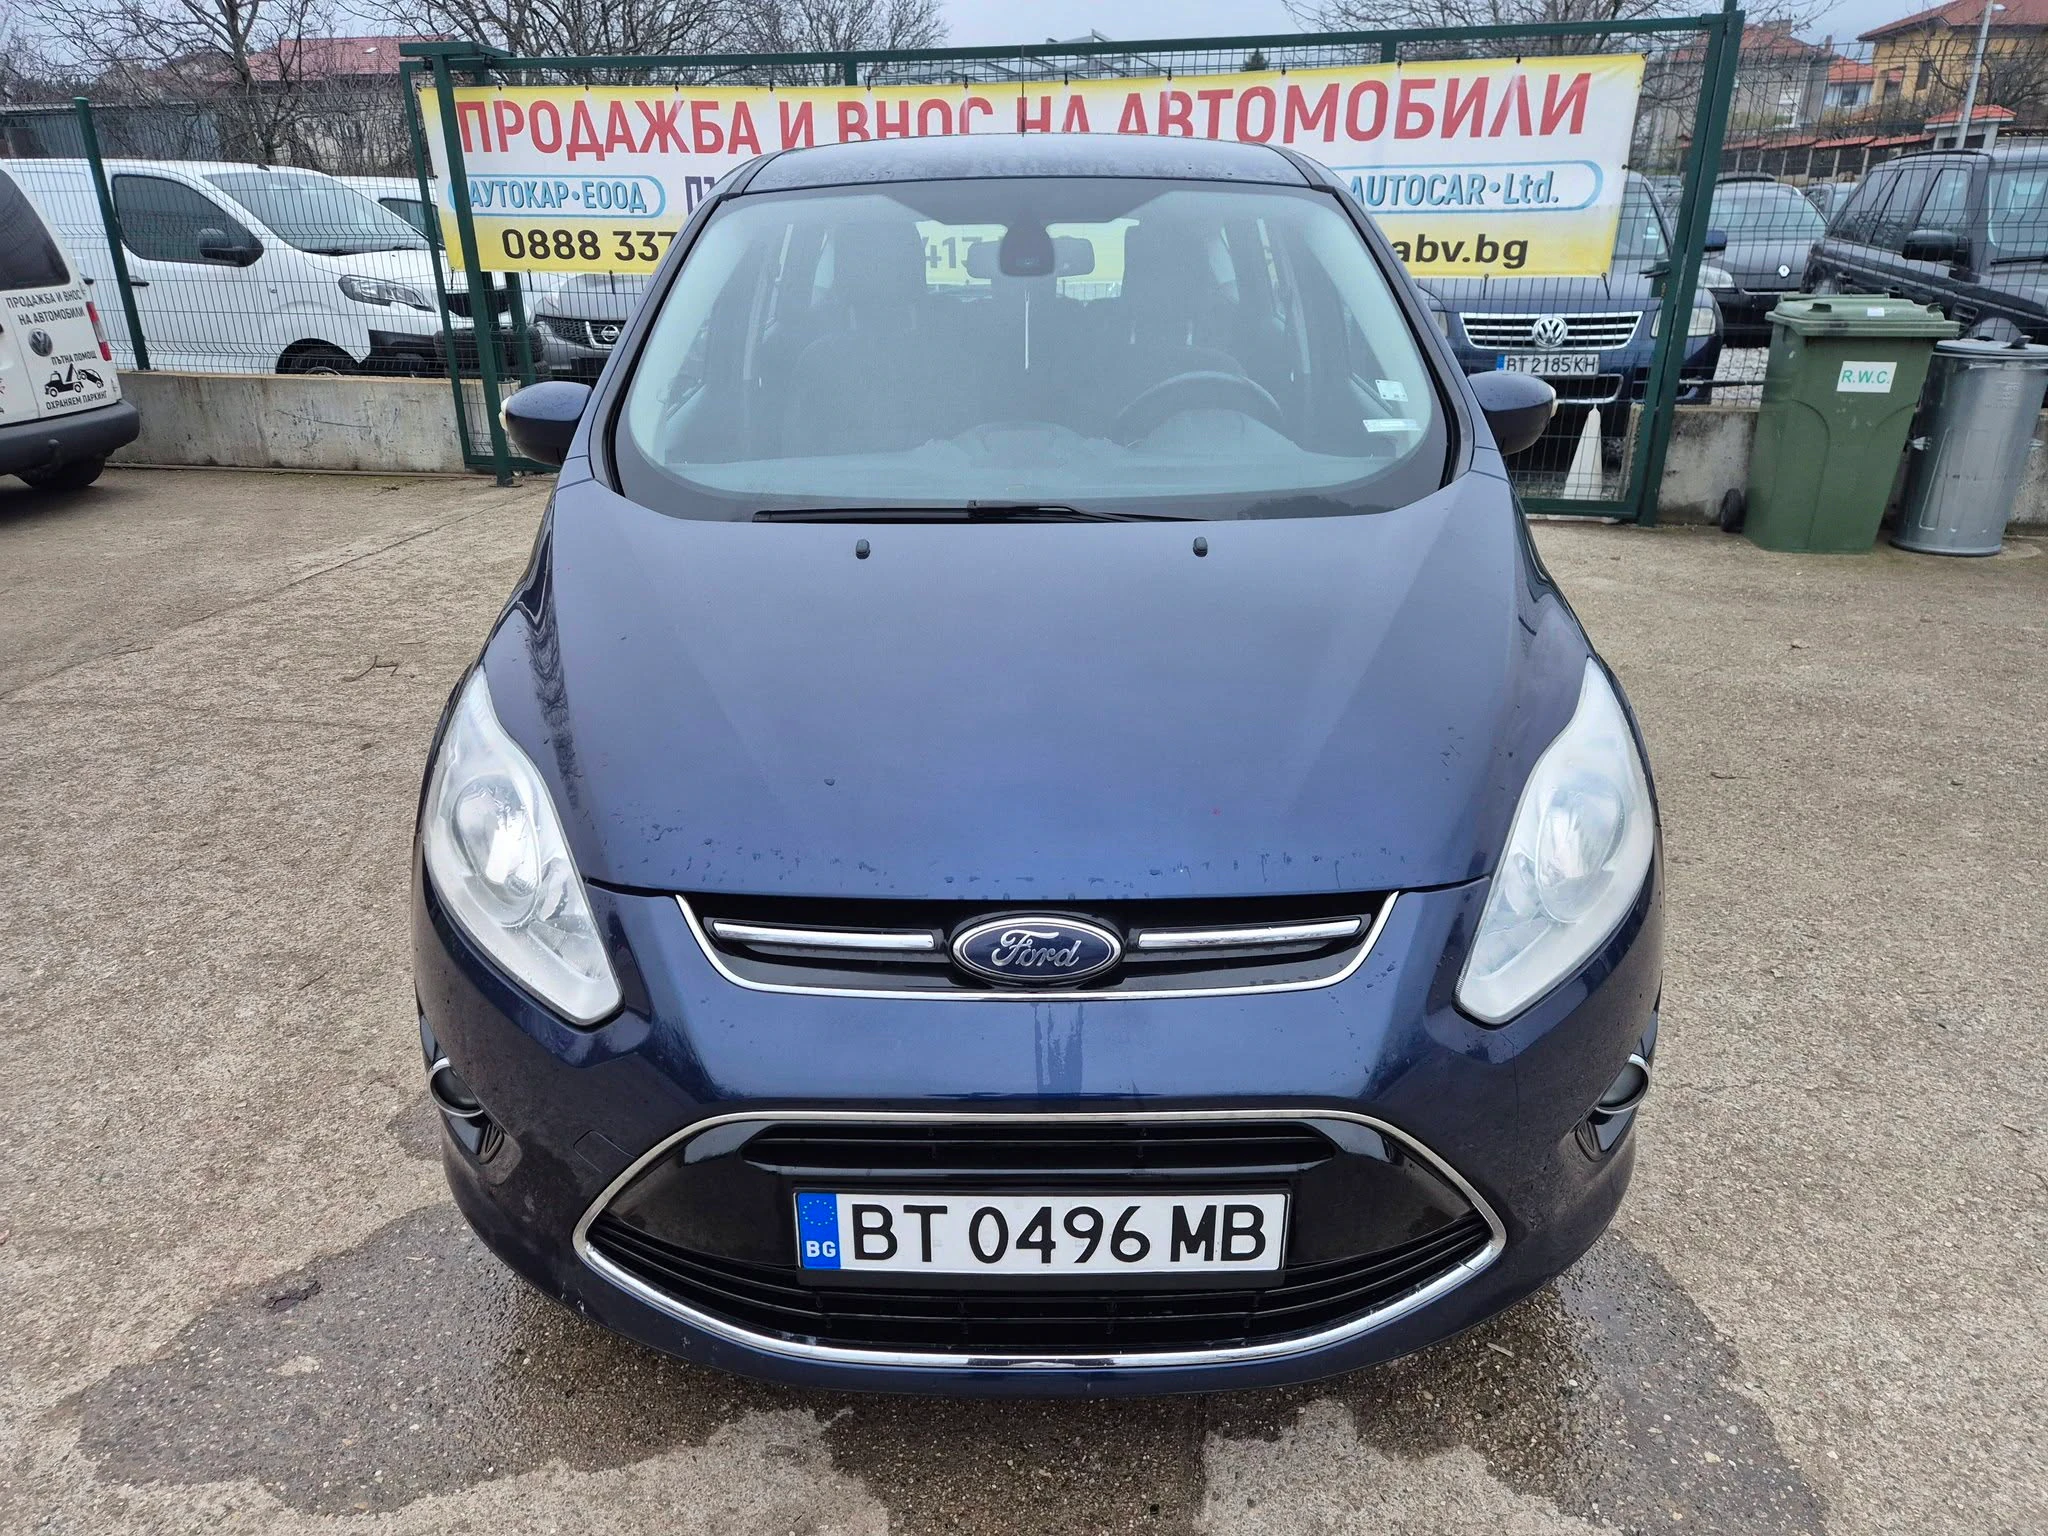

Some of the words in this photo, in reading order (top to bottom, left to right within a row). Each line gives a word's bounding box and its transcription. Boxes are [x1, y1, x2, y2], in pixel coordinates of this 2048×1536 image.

[456, 100, 762, 161] ПРОДАЖБА
[779, 101, 814, 150] И
[837, 97, 993, 143] ВНОС
[1117, 73, 1592, 144] АВТОМОБИЛИ
[502, 229, 600, 260] 0888
[6, 293, 56, 309] ПРОДАЖБА
[56, 292, 62, 301] И
[63, 290, 81, 301] ВНОС
[18, 313, 32, 325] НА
[33, 307, 85, 324] АВТОМОБИЛИ
[51, 354, 74, 365] ПЪТНА
[74, 350, 97, 362] ПОМОЩ
[1531, 357, 1570, 373] 2185
[1841, 370, 1890, 385] R.W.C.
[46, 396, 82, 410] ОХРАНЯЕМ
[83, 390, 107, 403] ПАРКИНГ
[991, 929, 1082, 967] Ford
[968, 1205, 1151, 1265] 0496
[806, 1240, 836, 1258] BG
